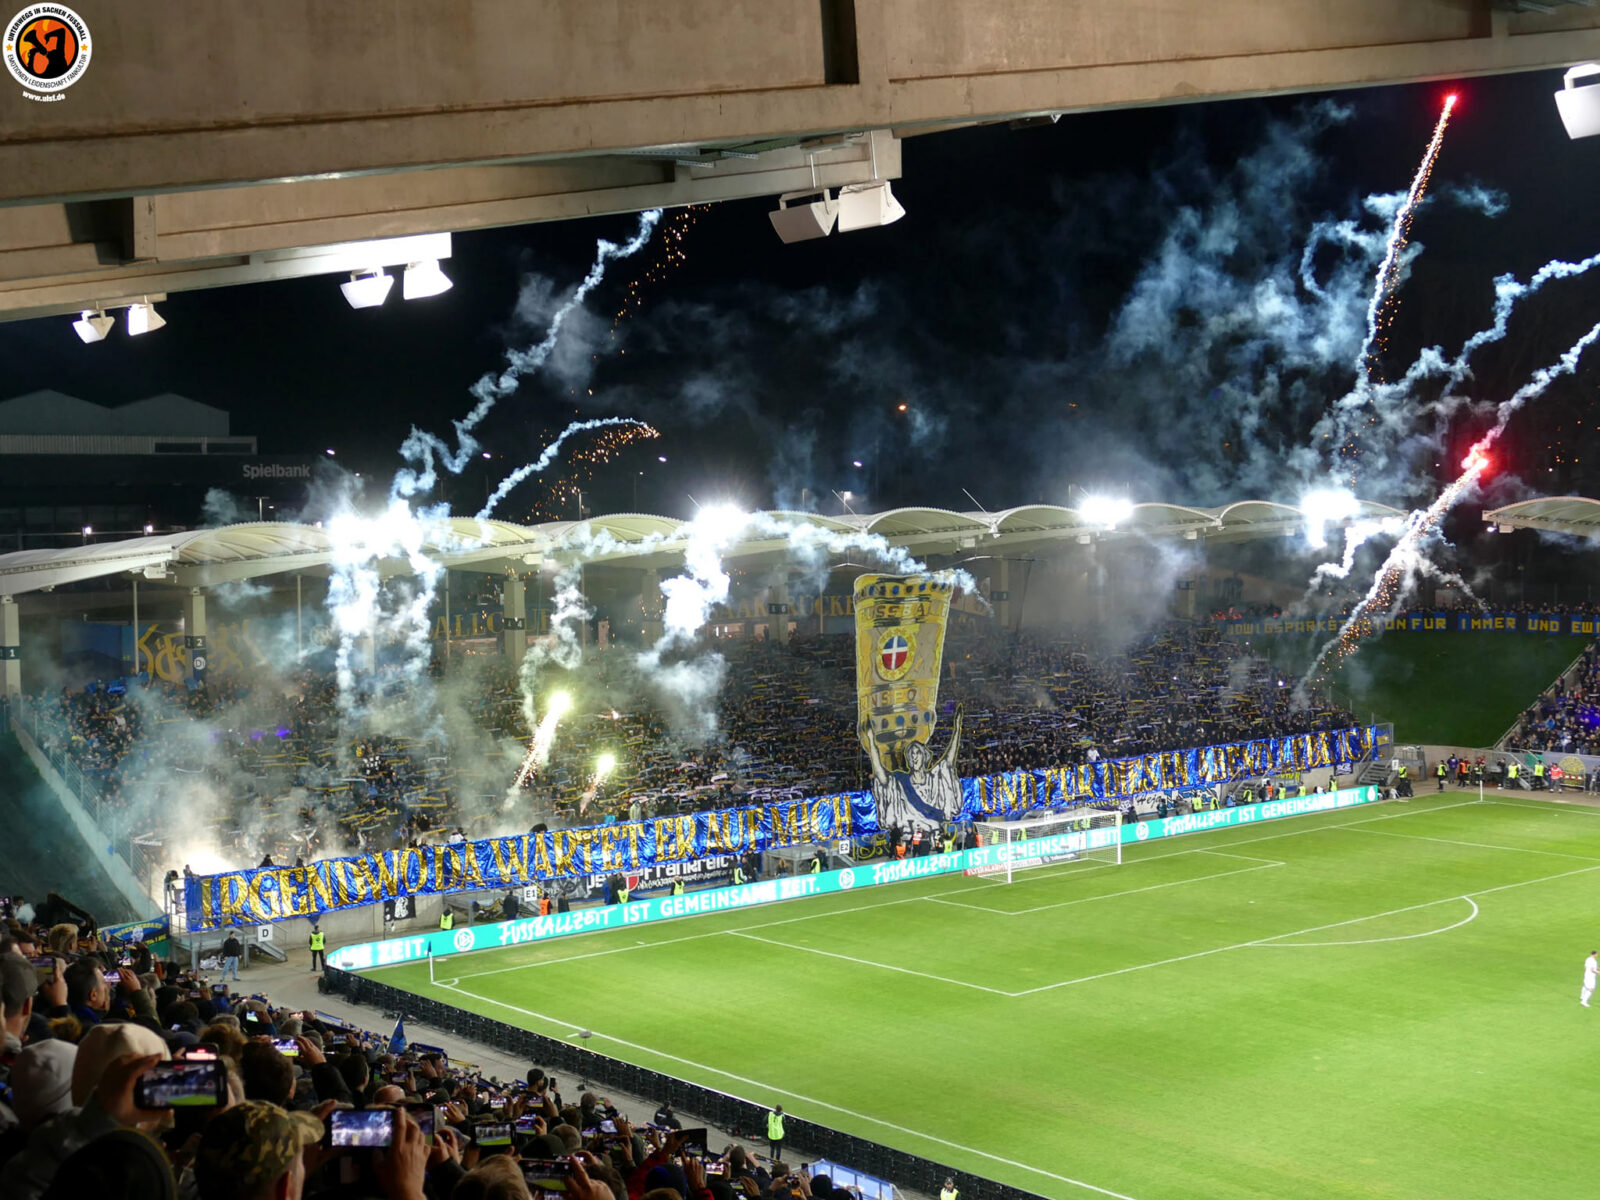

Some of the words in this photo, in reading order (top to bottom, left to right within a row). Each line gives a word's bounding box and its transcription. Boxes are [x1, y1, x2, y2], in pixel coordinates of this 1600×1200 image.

[242, 464, 311, 480] Spielbank
[1461, 617, 1516, 630] IMMER
[1528, 618, 1560, 632] UND
[9, 648, 15, 657] 1
[434, 842, 486, 892] DA
[490, 823, 646, 883] WARTET
[654, 815, 698, 863] ER
[704, 807, 765, 856] AUF
[770, 795, 853, 848] MICH
[978, 772, 1037, 814] UND
[1102, 752, 1189, 798] DIESEN
[1198, 741, 1274, 783] ABEND
[1161, 808, 1236, 837] FUSSBALLZEIT
[1238, 805, 1260, 823] IST
[1262, 791, 1334, 818] GEMEINSAME
[840, 843, 849, 852] E2
[873, 852, 963, 885] FUSSBALLZEIT
[968, 849, 990, 866] IST
[997, 832, 1087, 863] GEMEINSAME
[525, 886, 537, 898] E1
[498, 906, 617, 945] FUSSBALLZEIT
[623, 902, 651, 923] IST
[660, 880, 777, 917] GEMEINSAME
[780, 876, 820, 896] ZEIT.
[261, 929, 269, 938] D
[377, 938, 428, 963] ZEIT.
